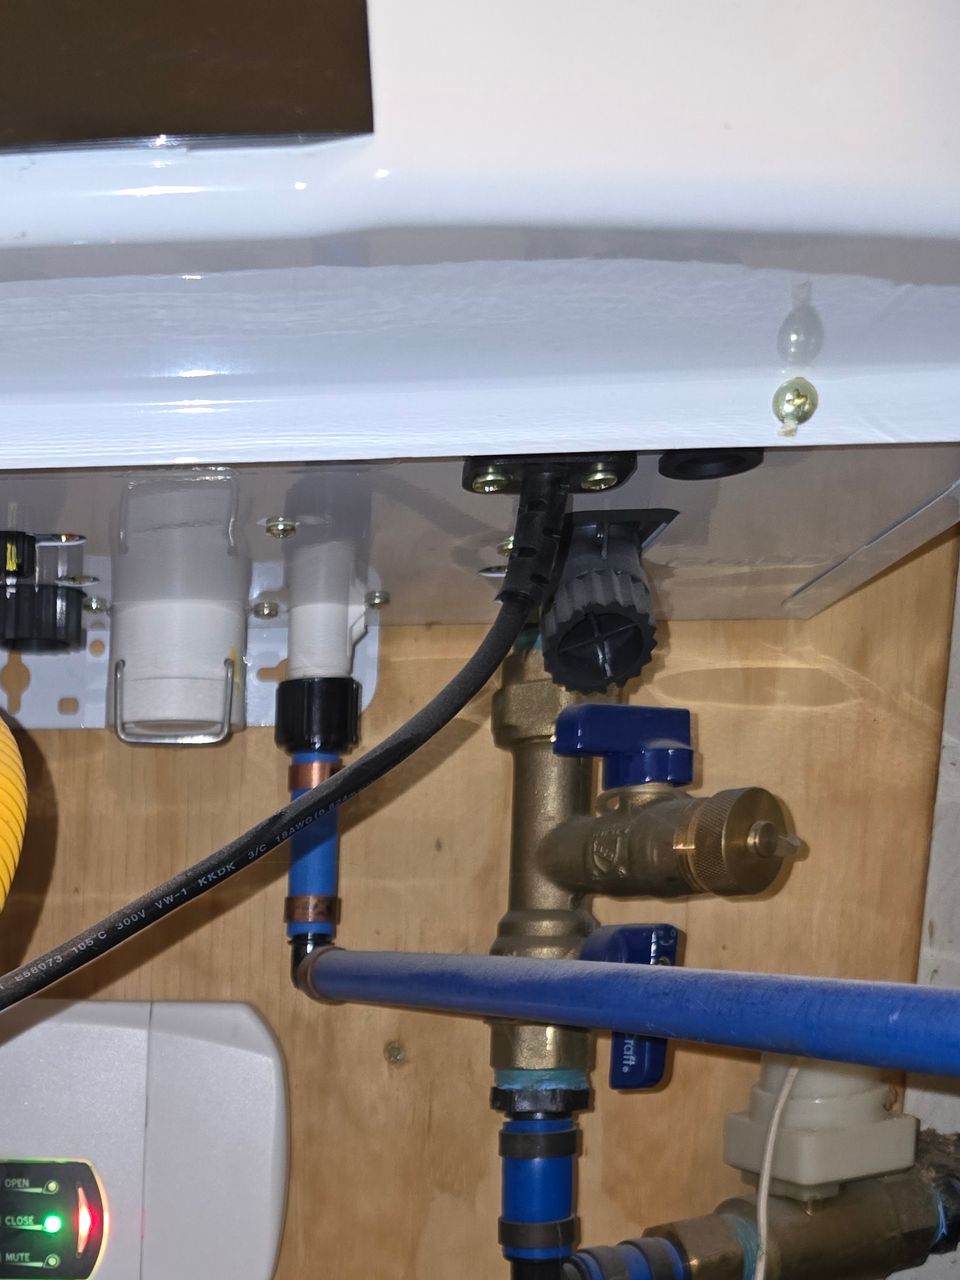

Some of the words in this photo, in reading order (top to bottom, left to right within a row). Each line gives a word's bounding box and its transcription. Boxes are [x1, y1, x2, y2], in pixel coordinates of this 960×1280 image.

[115, 908, 146, 931] 300V
[154, 888, 188, 909] VW-1
[197, 862, 236, 888] KKDK
[247, 844, 268, 861] 3/C
[5, 1179, 29, 1188] OPEN
[5, 1216, 34, 1225] CLOSE
[6, 1253, 30, 1262] MUTE
